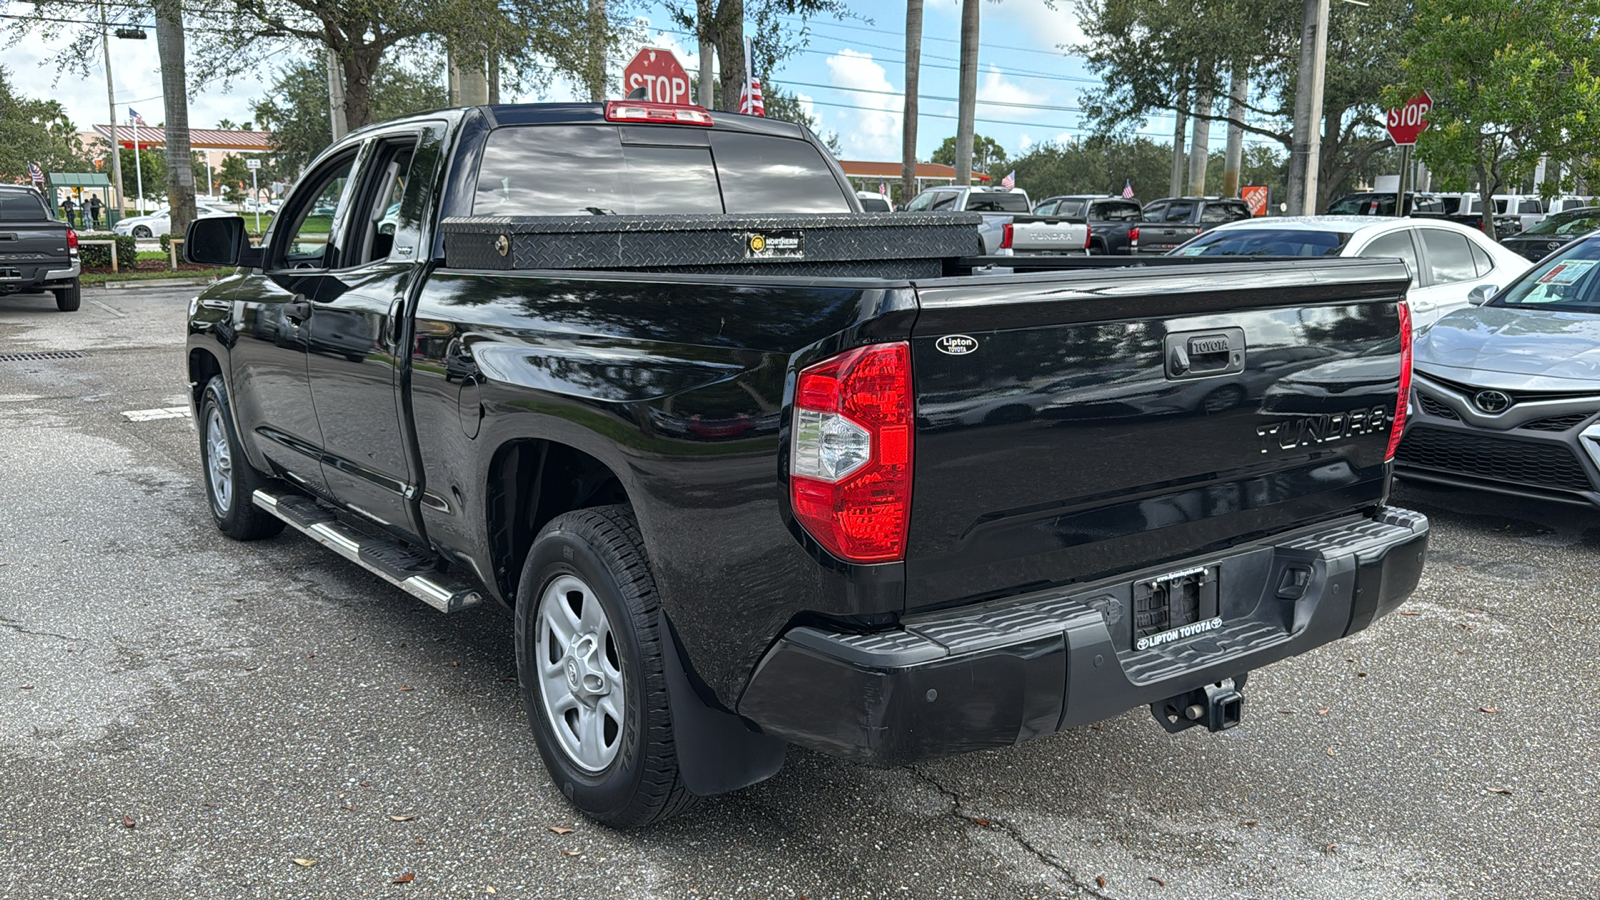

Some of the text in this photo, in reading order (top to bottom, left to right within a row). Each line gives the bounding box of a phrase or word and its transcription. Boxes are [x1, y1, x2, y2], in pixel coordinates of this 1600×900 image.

[630, 73, 686, 104] STOP
[1389, 103, 1429, 127] STOP
[765, 238, 798, 246] NORTHERN
[1030, 232, 1072, 241] TUNDRA
[943, 338, 972, 347] Lipton
[1194, 340, 1229, 353] TOYOTA
[1256, 404, 1387, 454] TUNDRA
[1149, 621, 1212, 647] LIPTON TOYOTA
